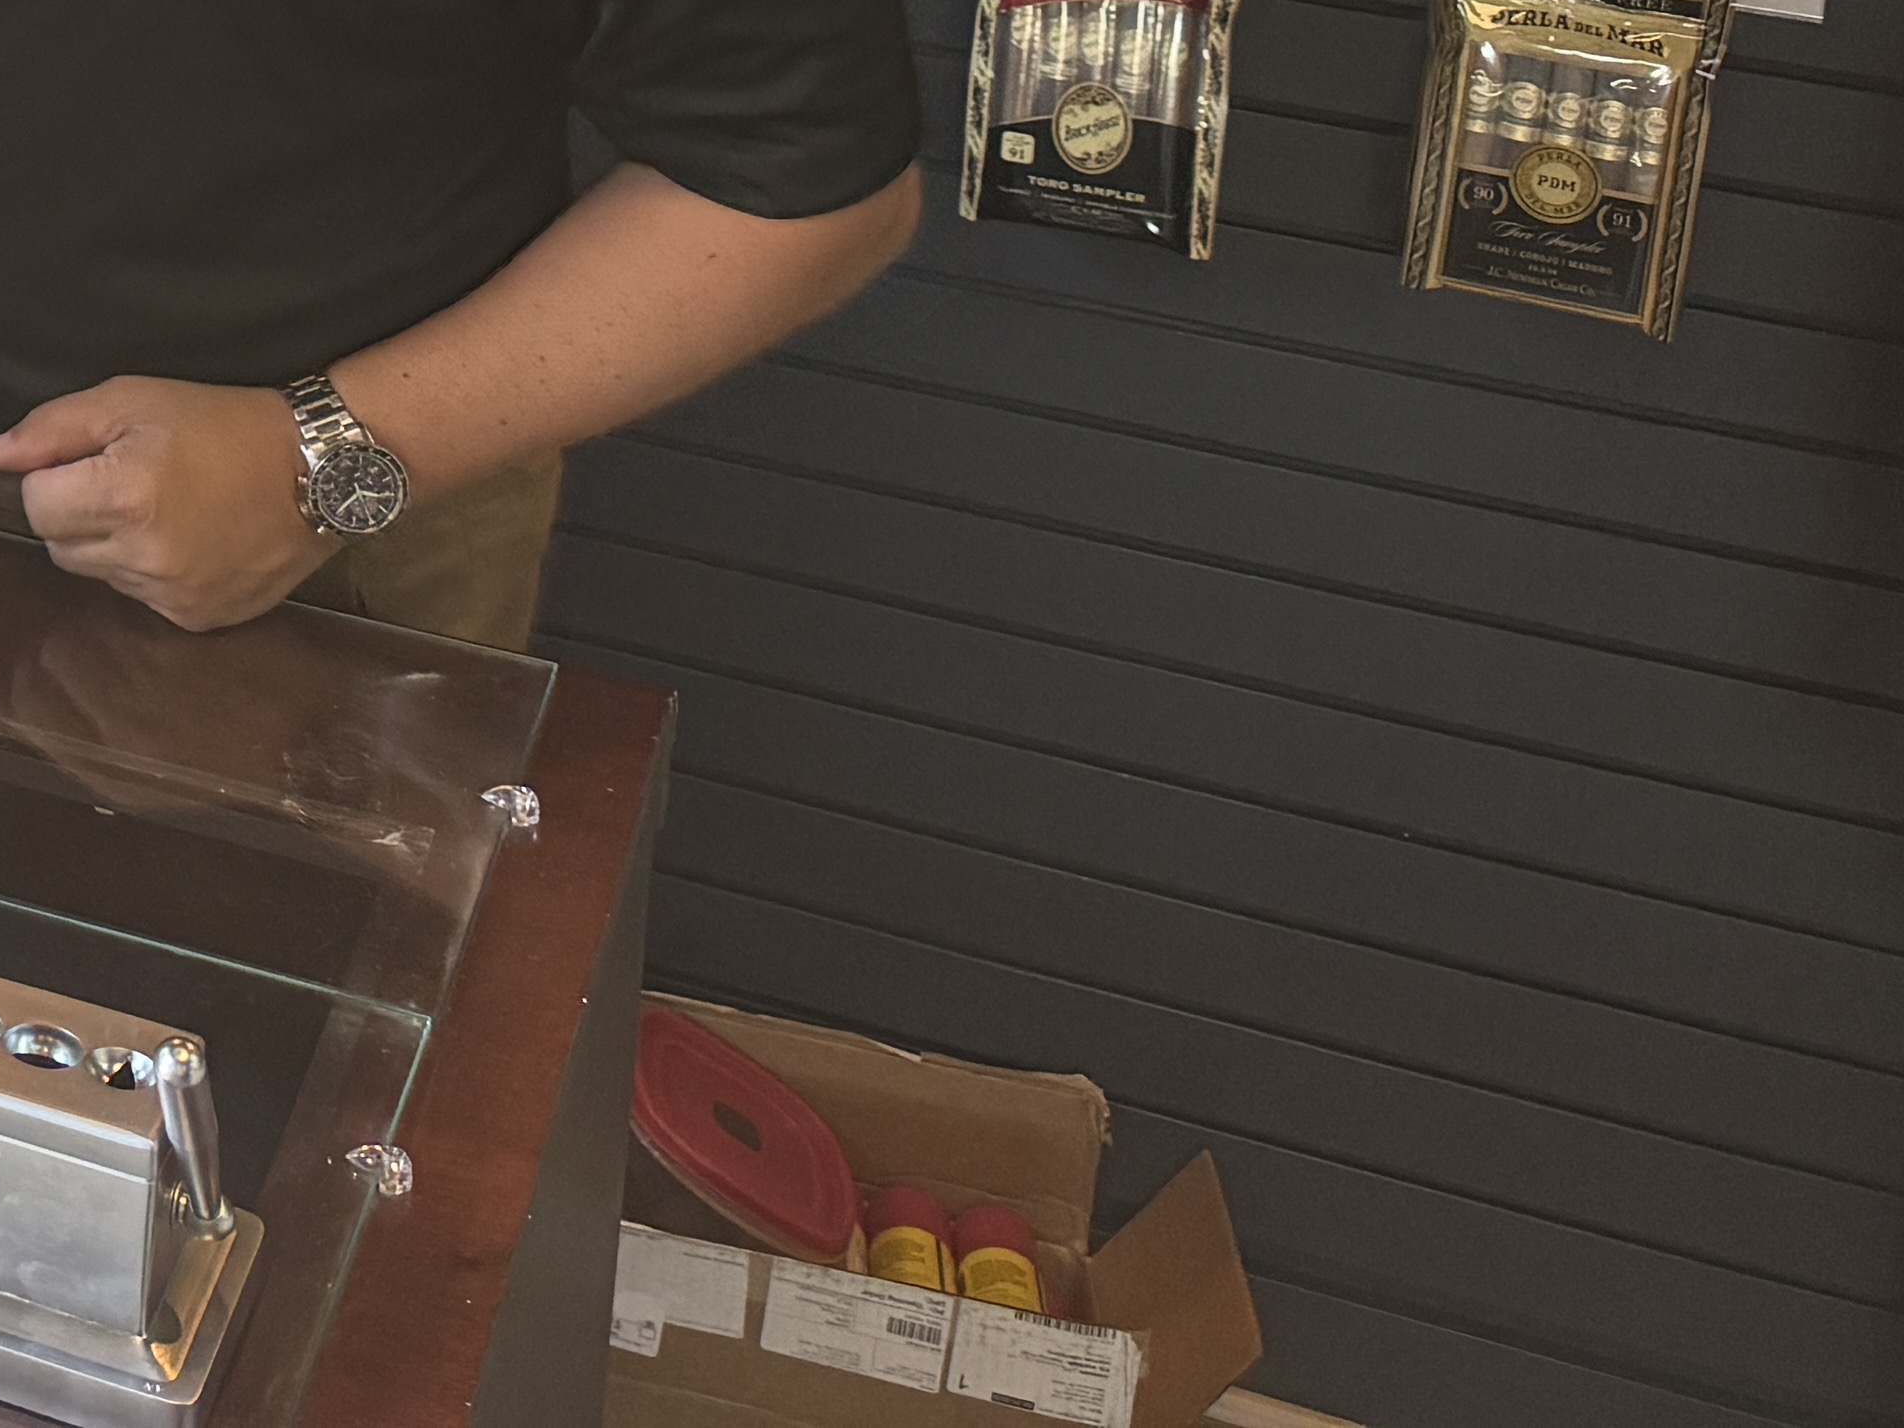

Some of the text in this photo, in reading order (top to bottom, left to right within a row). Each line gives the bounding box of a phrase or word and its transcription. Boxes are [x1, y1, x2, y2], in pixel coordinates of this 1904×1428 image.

[1573, 22, 1604, 38] DEL
[1606, 23, 1665, 58] MAR
[1007, 146, 1025, 161] 91
[1537, 151, 1583, 171] PERLA
[1027, 174, 1070, 191] TORO
[1071, 182, 1147, 204] SAMPLER
[1473, 185, 1495, 201] 90
[1537, 174, 1577, 193] PDM
[1612, 213, 1633, 229] 91
